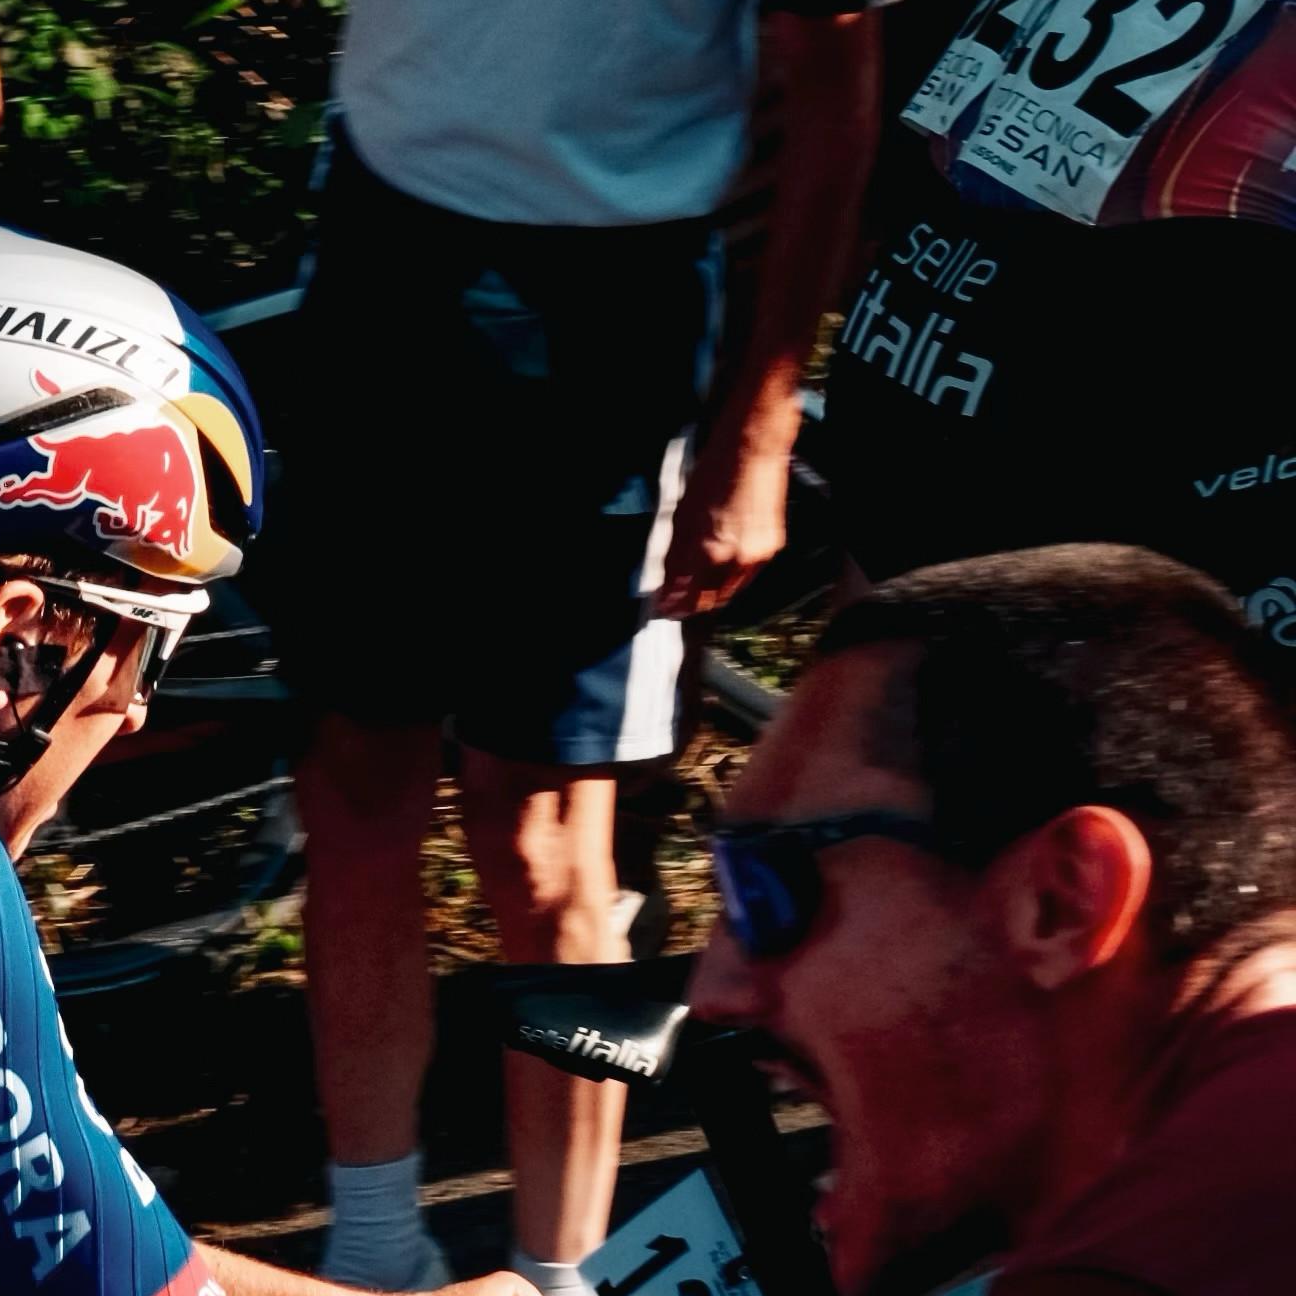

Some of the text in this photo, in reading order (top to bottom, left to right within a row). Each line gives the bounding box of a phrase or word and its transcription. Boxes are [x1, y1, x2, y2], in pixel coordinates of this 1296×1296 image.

[891, 222, 999, 303] selle
[840, 268, 995, 418] italia
[566, 1026, 659, 1078] italia
